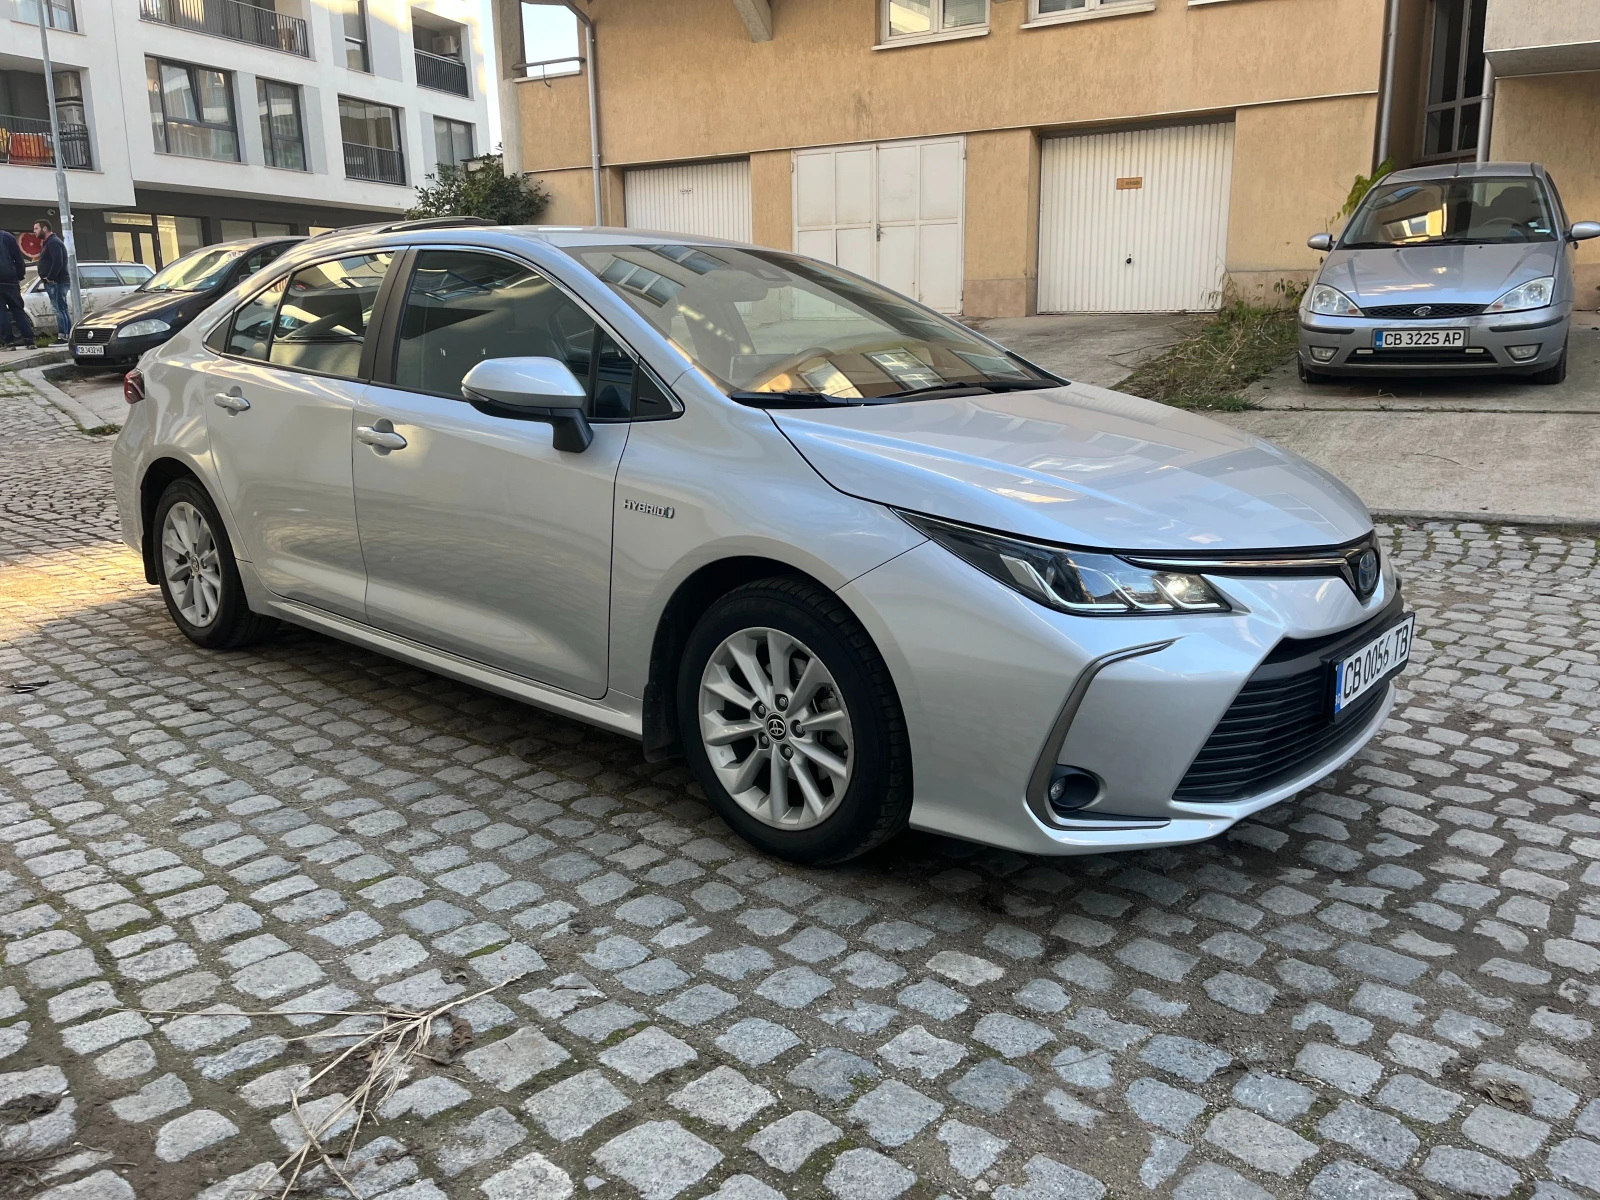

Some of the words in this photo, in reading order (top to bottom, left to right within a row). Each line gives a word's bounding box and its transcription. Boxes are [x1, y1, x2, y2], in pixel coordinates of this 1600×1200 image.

[1384, 333, 1402, 346] CB
[1405, 332, 1440, 346] 3225
[1442, 332, 1462, 345] AP
[623, 499, 666, 518] HYBRID
[1343, 656, 1362, 699] CB
[1363, 634, 1391, 685] 0056
[1394, 624, 1409, 662] TB
